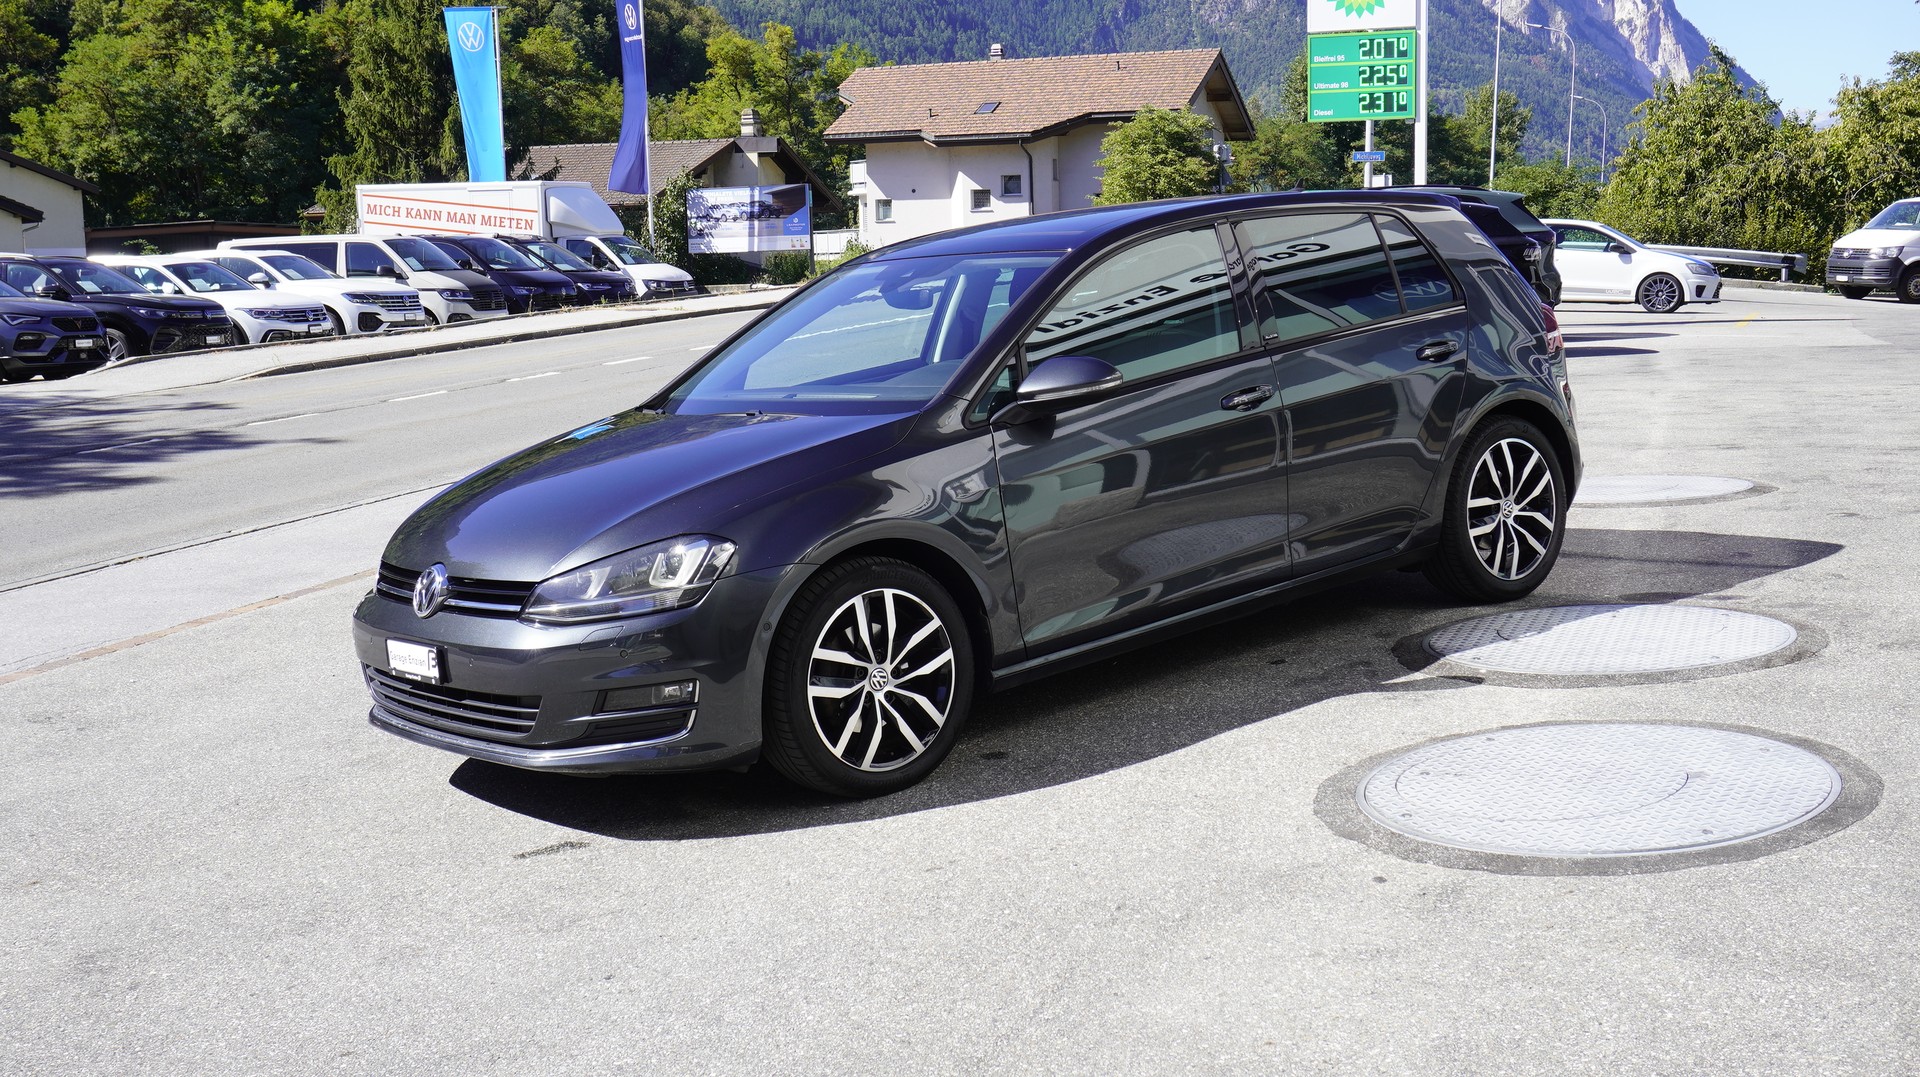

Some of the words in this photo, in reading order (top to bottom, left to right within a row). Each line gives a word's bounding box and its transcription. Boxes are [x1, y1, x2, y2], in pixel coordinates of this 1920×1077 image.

[366, 203, 402, 217] MICH
[405, 207, 442, 221] KANN
[446, 211, 476, 225] MAN
[480, 214, 534, 231] MIETEN
[389, 650, 408, 665] Garage
